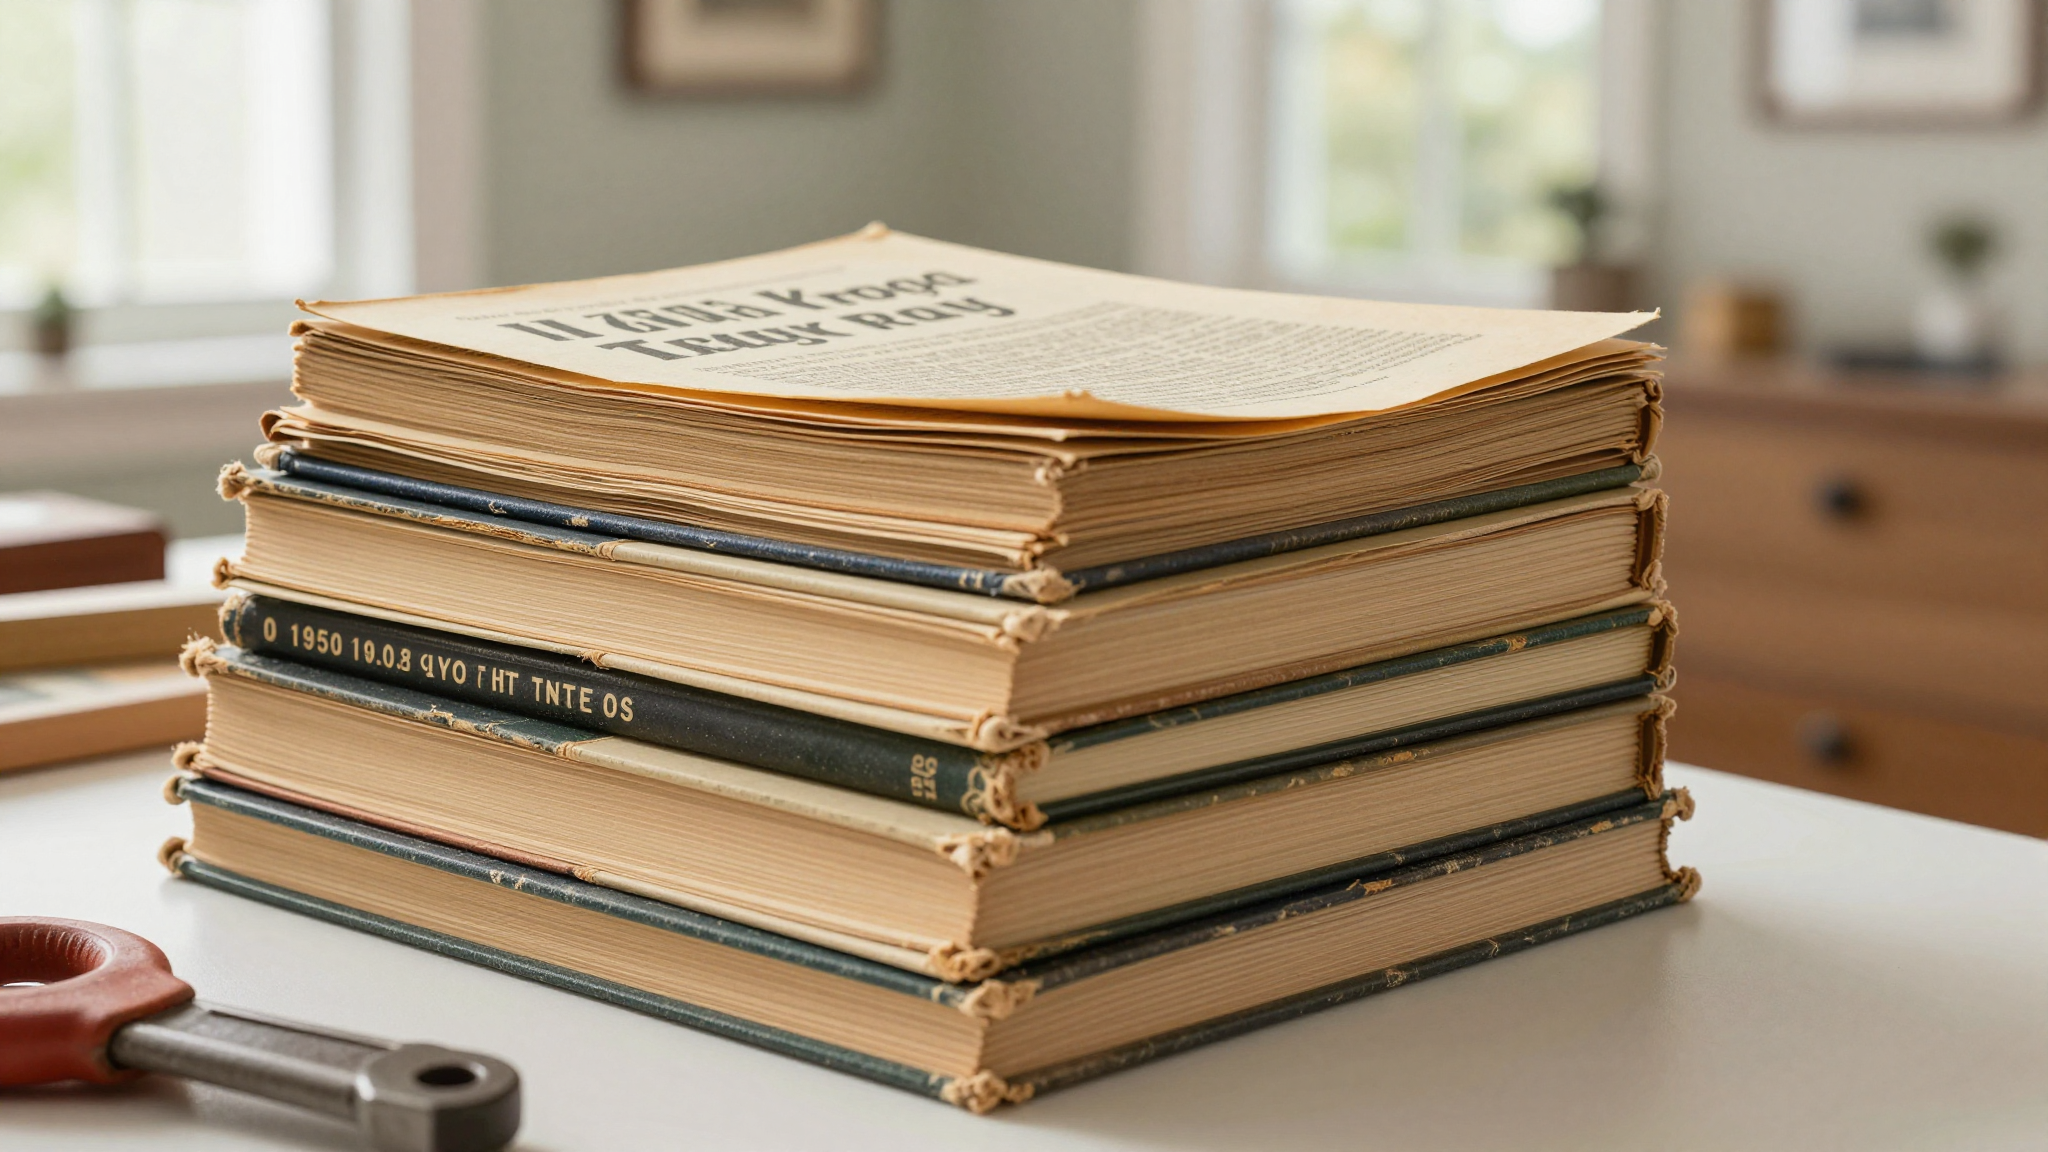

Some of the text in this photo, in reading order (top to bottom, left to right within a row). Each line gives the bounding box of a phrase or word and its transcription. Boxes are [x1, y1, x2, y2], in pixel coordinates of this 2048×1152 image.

[290, 624, 343, 656] 1950
[531, 676, 594, 714] TNTE
[602, 692, 634, 722] OS
